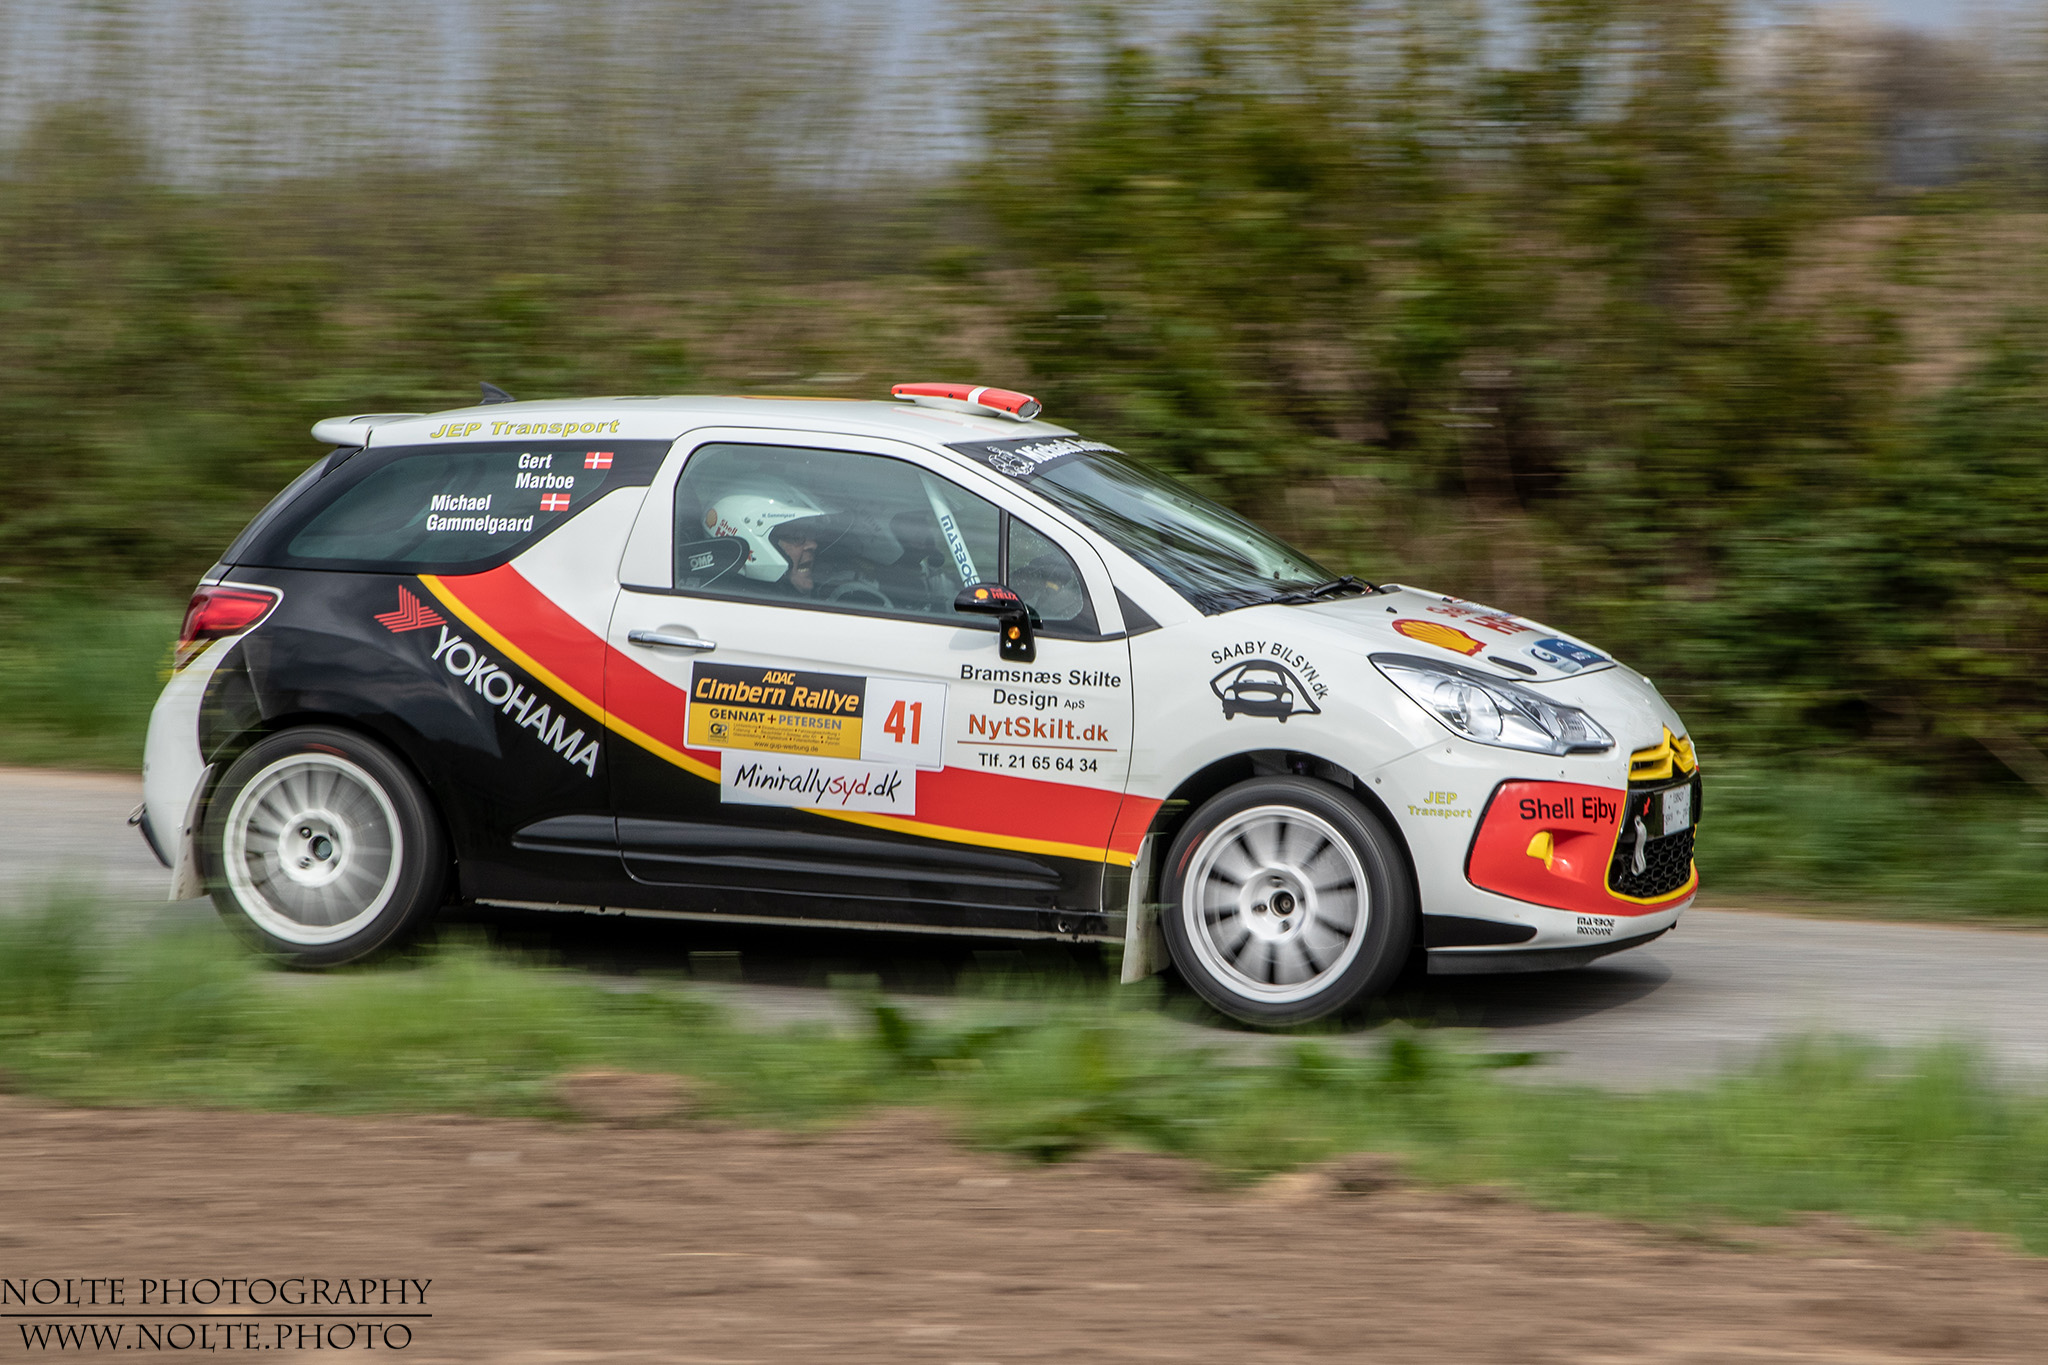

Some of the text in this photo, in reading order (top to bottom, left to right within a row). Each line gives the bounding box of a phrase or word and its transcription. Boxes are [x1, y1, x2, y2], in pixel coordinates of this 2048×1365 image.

[430, 419, 621, 438] JEP Transport
[518, 453, 553, 469] Gert
[514, 472, 575, 489] Marboe
[430, 494, 492, 511] Michael
[426, 514, 534, 535] Gammelgaard
[720, 519, 738, 537] Shell
[690, 555, 713, 568] OMP
[762, 670, 796, 686] ADAC
[960, 664, 1121, 688] Bramsnæs Skilte
[1211, 640, 1329, 700] SAABY BILSYN.dk
[431, 624, 600, 779] YOKOHAMA
[695, 677, 860, 714] Cimbern Rallye
[993, 689, 1085, 711] Design ApS
[709, 707, 765, 723] GENNAT
[778, 714, 842, 730] PETERSEN
[883, 700, 923, 745] 41
[968, 713, 1109, 742] NytSkilt.dk
[978, 752, 1098, 773] Tlf. 21 65 64 34
[734, 762, 902, 805] Minirallysyd.dk
[1407, 791, 1473, 819] JEP Transport
[1518, 796, 1617, 825] Shell Ejby
